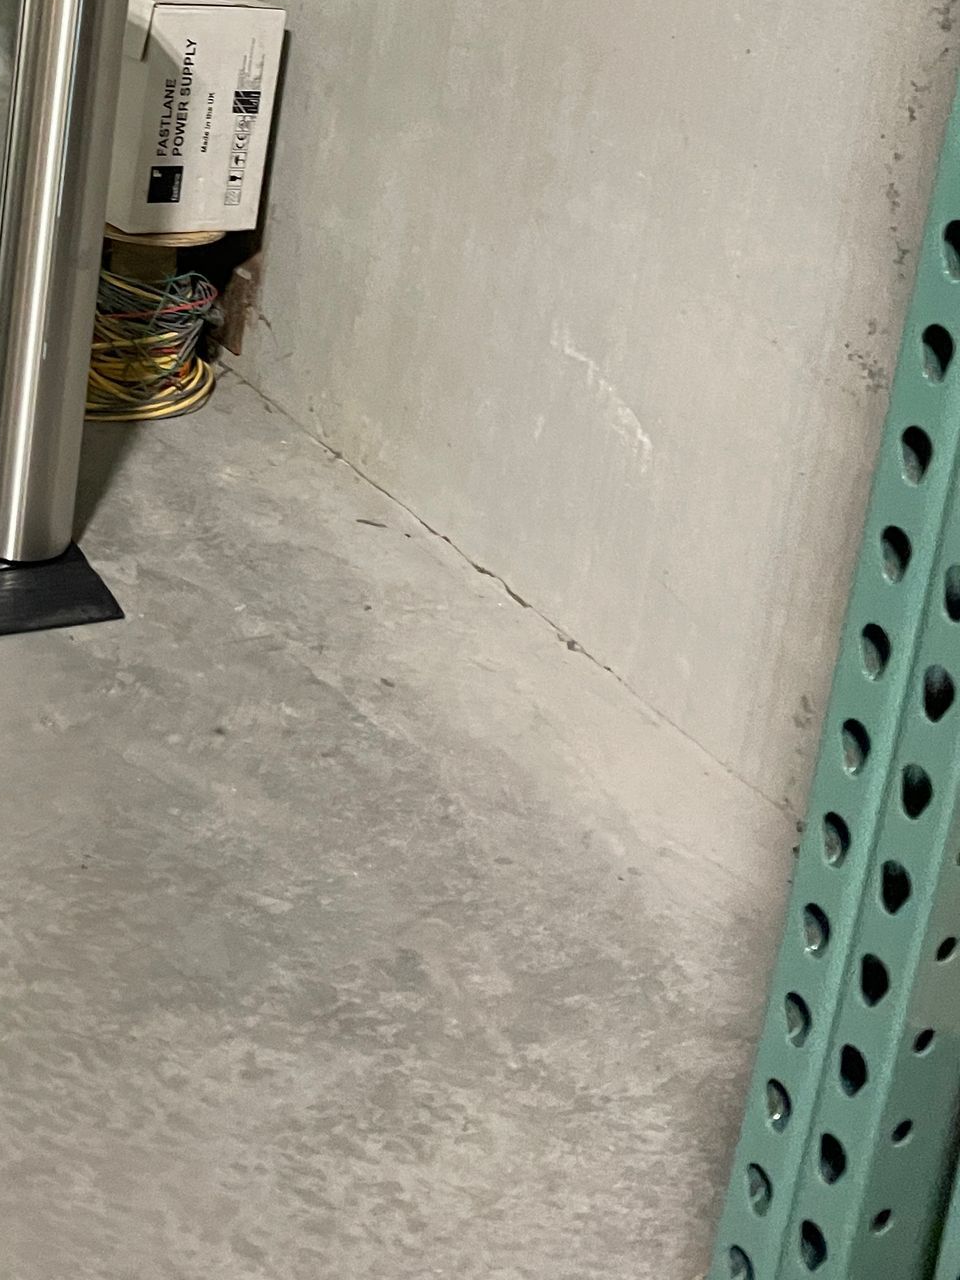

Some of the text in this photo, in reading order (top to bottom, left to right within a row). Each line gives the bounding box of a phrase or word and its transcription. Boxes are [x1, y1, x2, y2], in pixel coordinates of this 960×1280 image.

[156, 78, 177, 157] FASTLANE
[172, 39, 197, 157] POWER SUPPLY
[200, 131, 210, 153] Made
[207, 92, 215, 105] UK
